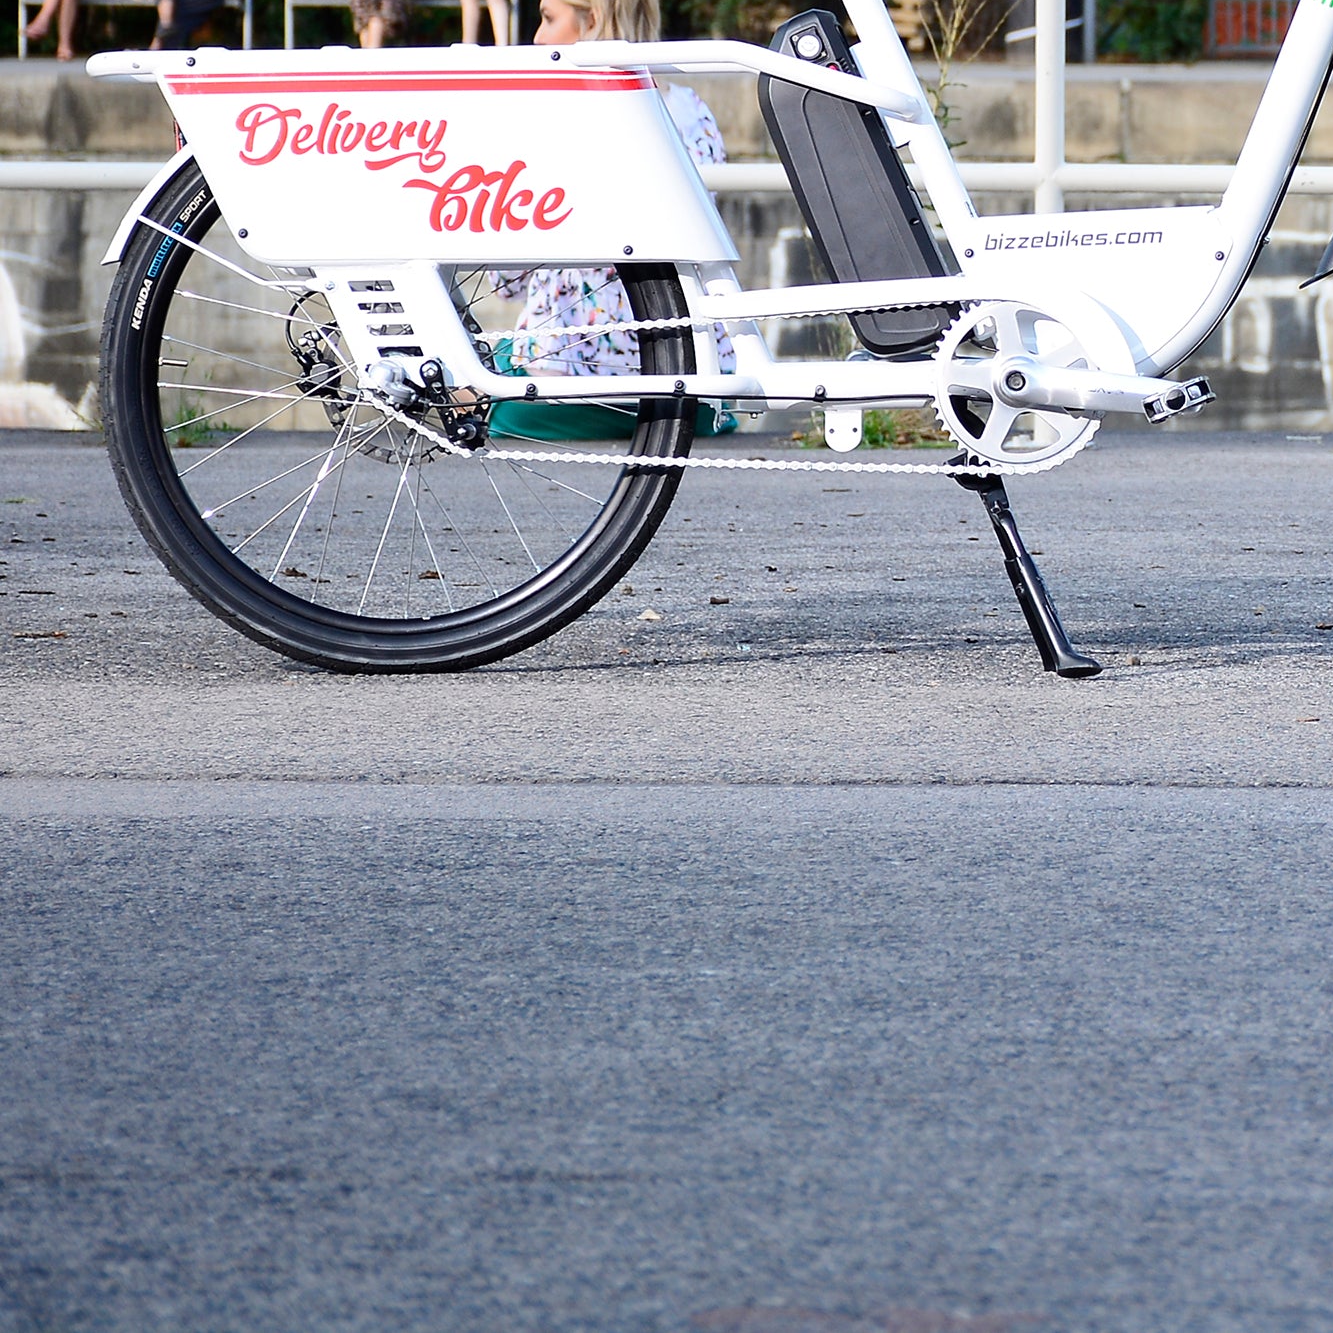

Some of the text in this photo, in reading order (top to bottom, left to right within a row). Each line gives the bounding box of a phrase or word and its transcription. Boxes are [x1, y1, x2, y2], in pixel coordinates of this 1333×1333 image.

[235, 102, 448, 173] Delivery
[131, 278, 153, 331] KENDA
[179, 189, 207, 223] SPORT
[984, 230, 1163, 251] bizzebikes.com
